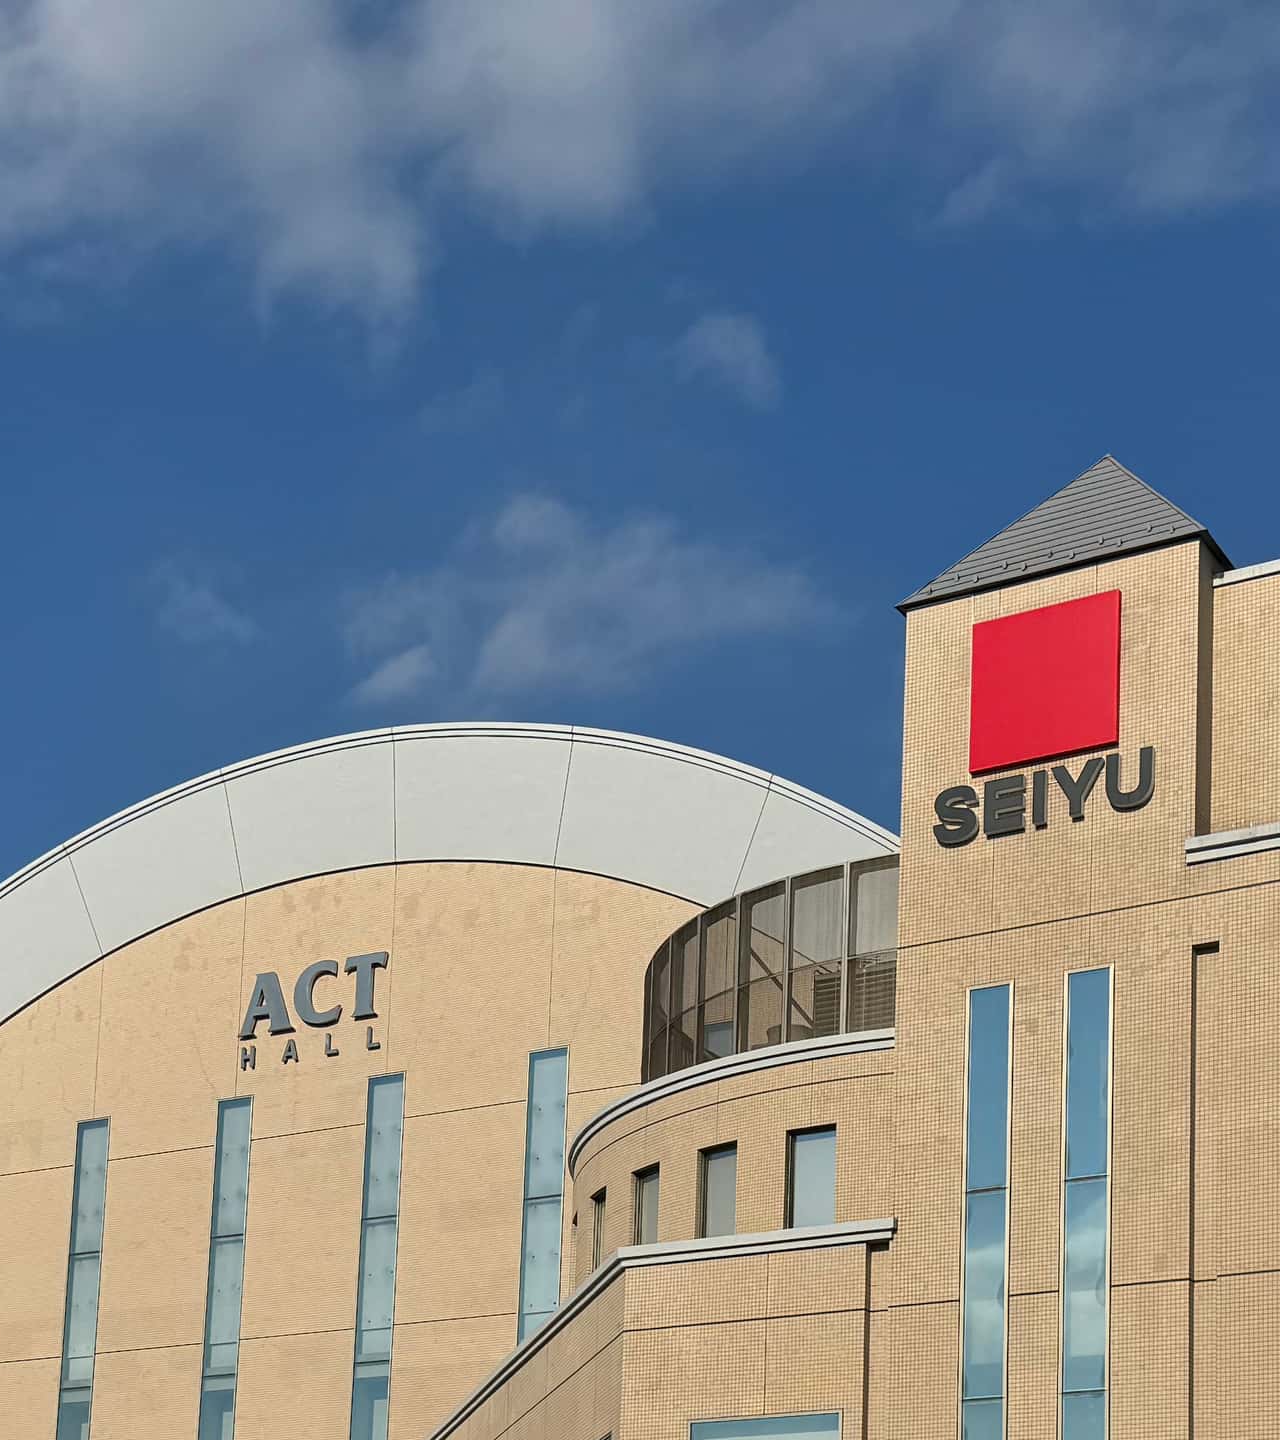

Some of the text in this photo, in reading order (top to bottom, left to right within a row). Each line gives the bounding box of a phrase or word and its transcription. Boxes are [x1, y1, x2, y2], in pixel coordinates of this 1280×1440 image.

[933, 746, 1155, 848] SEIYU
[238, 951, 389, 1041] ACT
[241, 1026, 381, 1071] HALL
